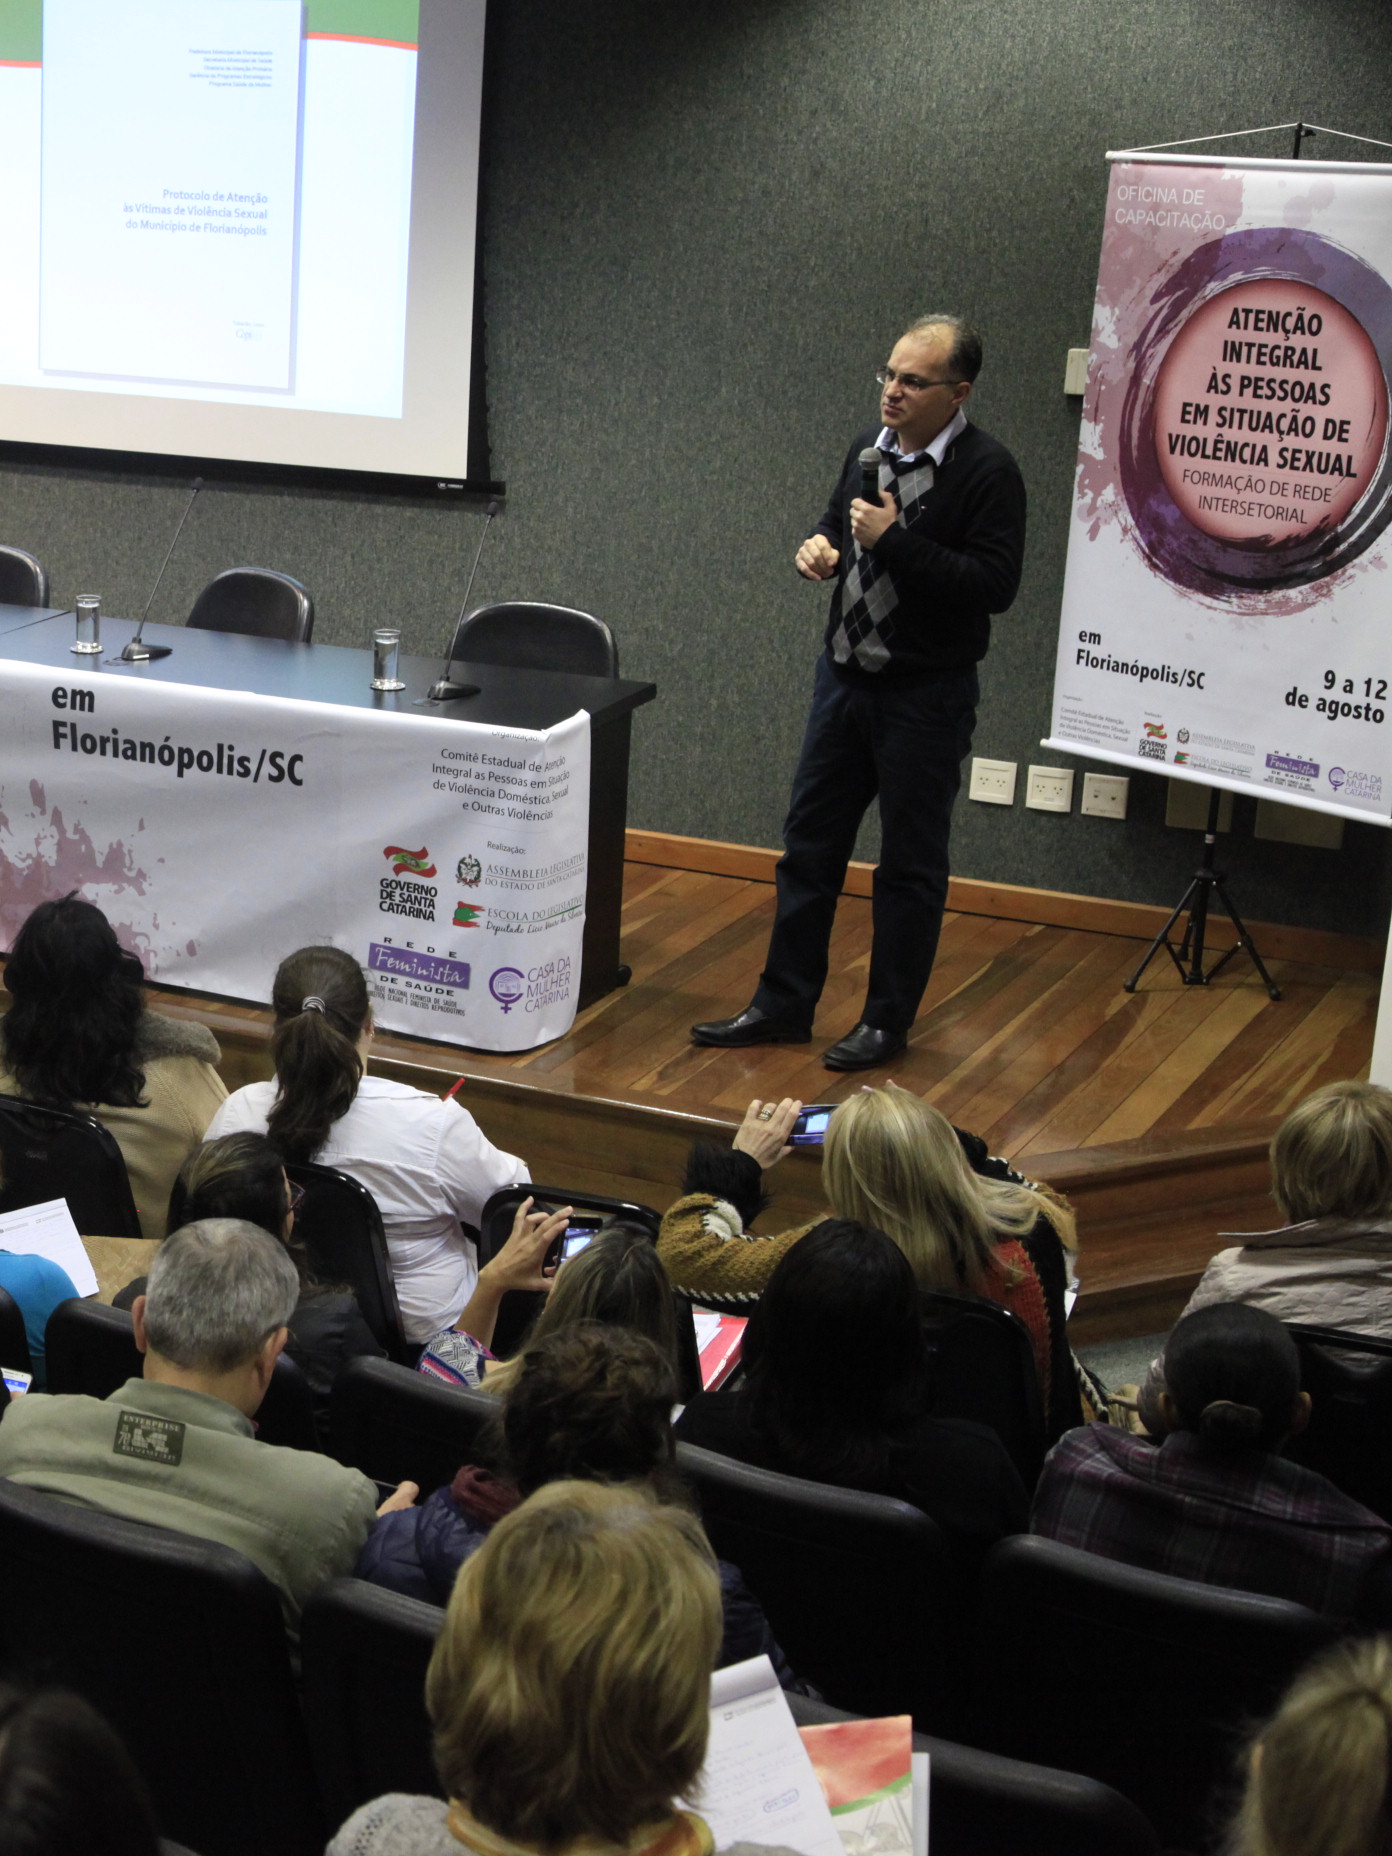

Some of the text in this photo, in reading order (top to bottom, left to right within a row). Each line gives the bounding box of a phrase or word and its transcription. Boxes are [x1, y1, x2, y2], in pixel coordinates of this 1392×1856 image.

[163, 189, 268, 206] Protocolo de Atenção
[1117, 185, 1205, 205] OFICINA DE
[135, 203, 171, 215] Vítimas
[174, 206, 185, 215] de
[187, 206, 232, 218] Violência
[234, 208, 268, 220] Sexual
[1115, 208, 1225, 232] CAPACITAÇÃO
[126, 219, 138, 229] do
[189, 222, 201, 233] de
[204, 223, 267, 237] Florianópolis
[1227, 306, 1323, 341] ATENÇÃO
[1222, 339, 1323, 371] INTEGRAL
[1206, 366, 1331, 406] ÀS PESSOAS
[1180, 401, 1351, 443] EM SITUAÇÃO DE
[1168, 433, 1357, 478] VIOLÊNCIA SEXUAL
[1182, 469, 1333, 503] FORMAÇÃO DE REDE
[1198, 495, 1308, 524] INTERSETORIAL
[1079, 630, 1101, 646] em
[1076, 648, 1206, 690] Florianópolis/SC
[1324, 669, 1388, 701] 9 a 12
[51, 685, 95, 713] em
[1285, 686, 1385, 724] de agosto
[52, 719, 304, 786] Florianópolis/SC
[1139, 738, 1168, 751] GOVERNO
[1139, 744, 1166, 756] DE SANTA
[440, 748, 566, 773] Comitê Estadual de Atenção
[1138, 751, 1166, 762] CATARINA
[1269, 755, 1316, 776] Feminista
[432, 763, 570, 789] Integral as Pessoas em Situação
[1345, 779, 1383, 794] MULHER
[1346, 770, 1383, 785] CASA DA
[433, 779, 569, 805] de Violência Doméstica, Sexual
[1344, 788, 1381, 801] CATARINA
[462, 801, 554, 822] e Outras Violências
[487, 840, 527, 855] Realização:
[487, 863, 548, 879] ASSEMBLEIA
[379, 878, 438, 898] GOVERNO
[484, 878, 498, 887] DO
[500, 879, 535, 891] ESTADO
[536, 879, 546, 890] DE
[379, 889, 436, 910] DE SANTA
[379, 901, 435, 922] CATARINA
[487, 908, 529, 921] ESCOLA
[532, 909, 546, 921] DO
[486, 920, 525, 936] Deputado
[383, 937, 457, 959] REDE
[375, 947, 465, 983] Feminista
[527, 956, 571, 983] CASA DA
[379, 975, 455, 997] DE SAÚDE
[527, 971, 571, 998] MULHER
[525, 987, 570, 1013] CATARINA
[124, 1414, 179, 1432] ENTERPRISE
